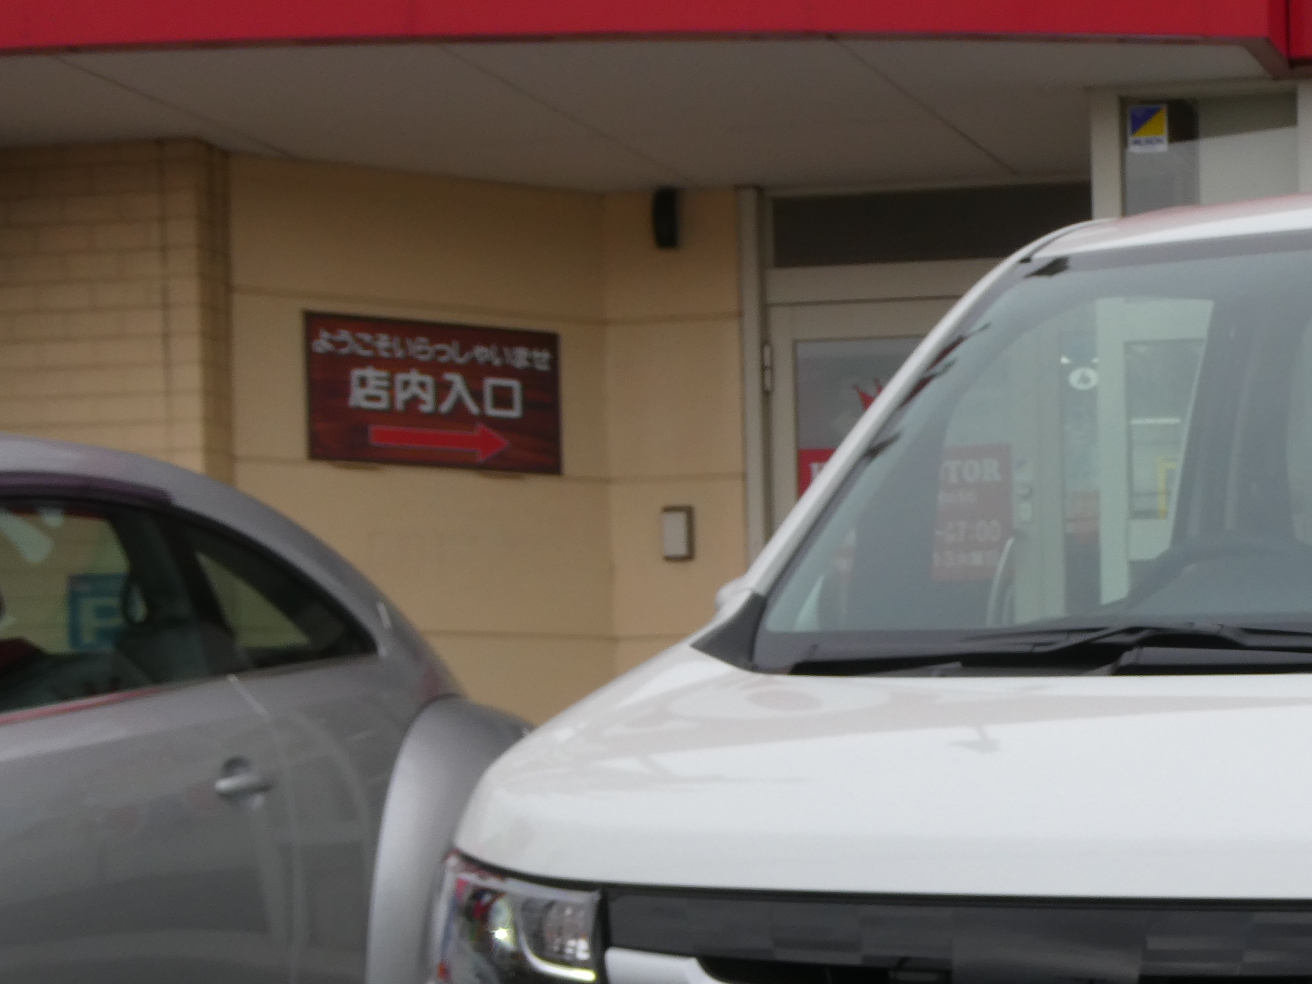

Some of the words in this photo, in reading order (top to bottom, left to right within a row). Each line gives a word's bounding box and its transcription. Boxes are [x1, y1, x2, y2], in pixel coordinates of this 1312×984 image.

[312, 329, 552, 371] ようこそいらっしゃいませ
[349, 366, 523, 419] 店内入口
